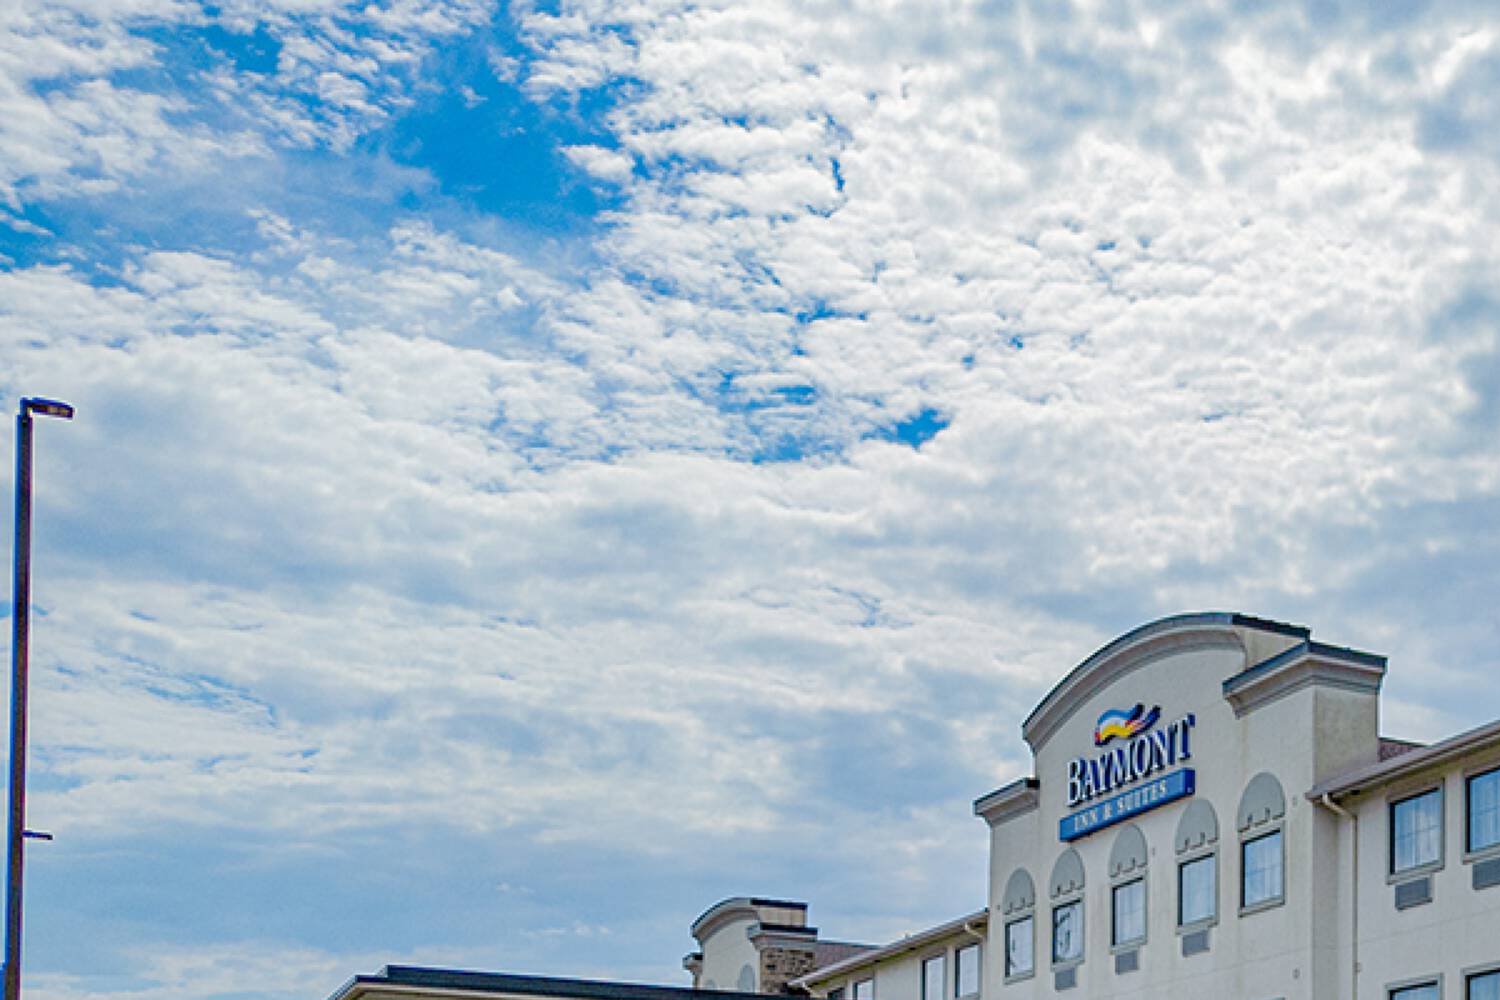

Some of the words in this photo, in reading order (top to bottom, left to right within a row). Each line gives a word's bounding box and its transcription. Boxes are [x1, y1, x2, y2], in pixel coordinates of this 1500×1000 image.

[1066, 713, 1195, 807] BAYMONT
[1074, 808, 1098, 833] INN
[1117, 779, 1167, 816] SUITES
